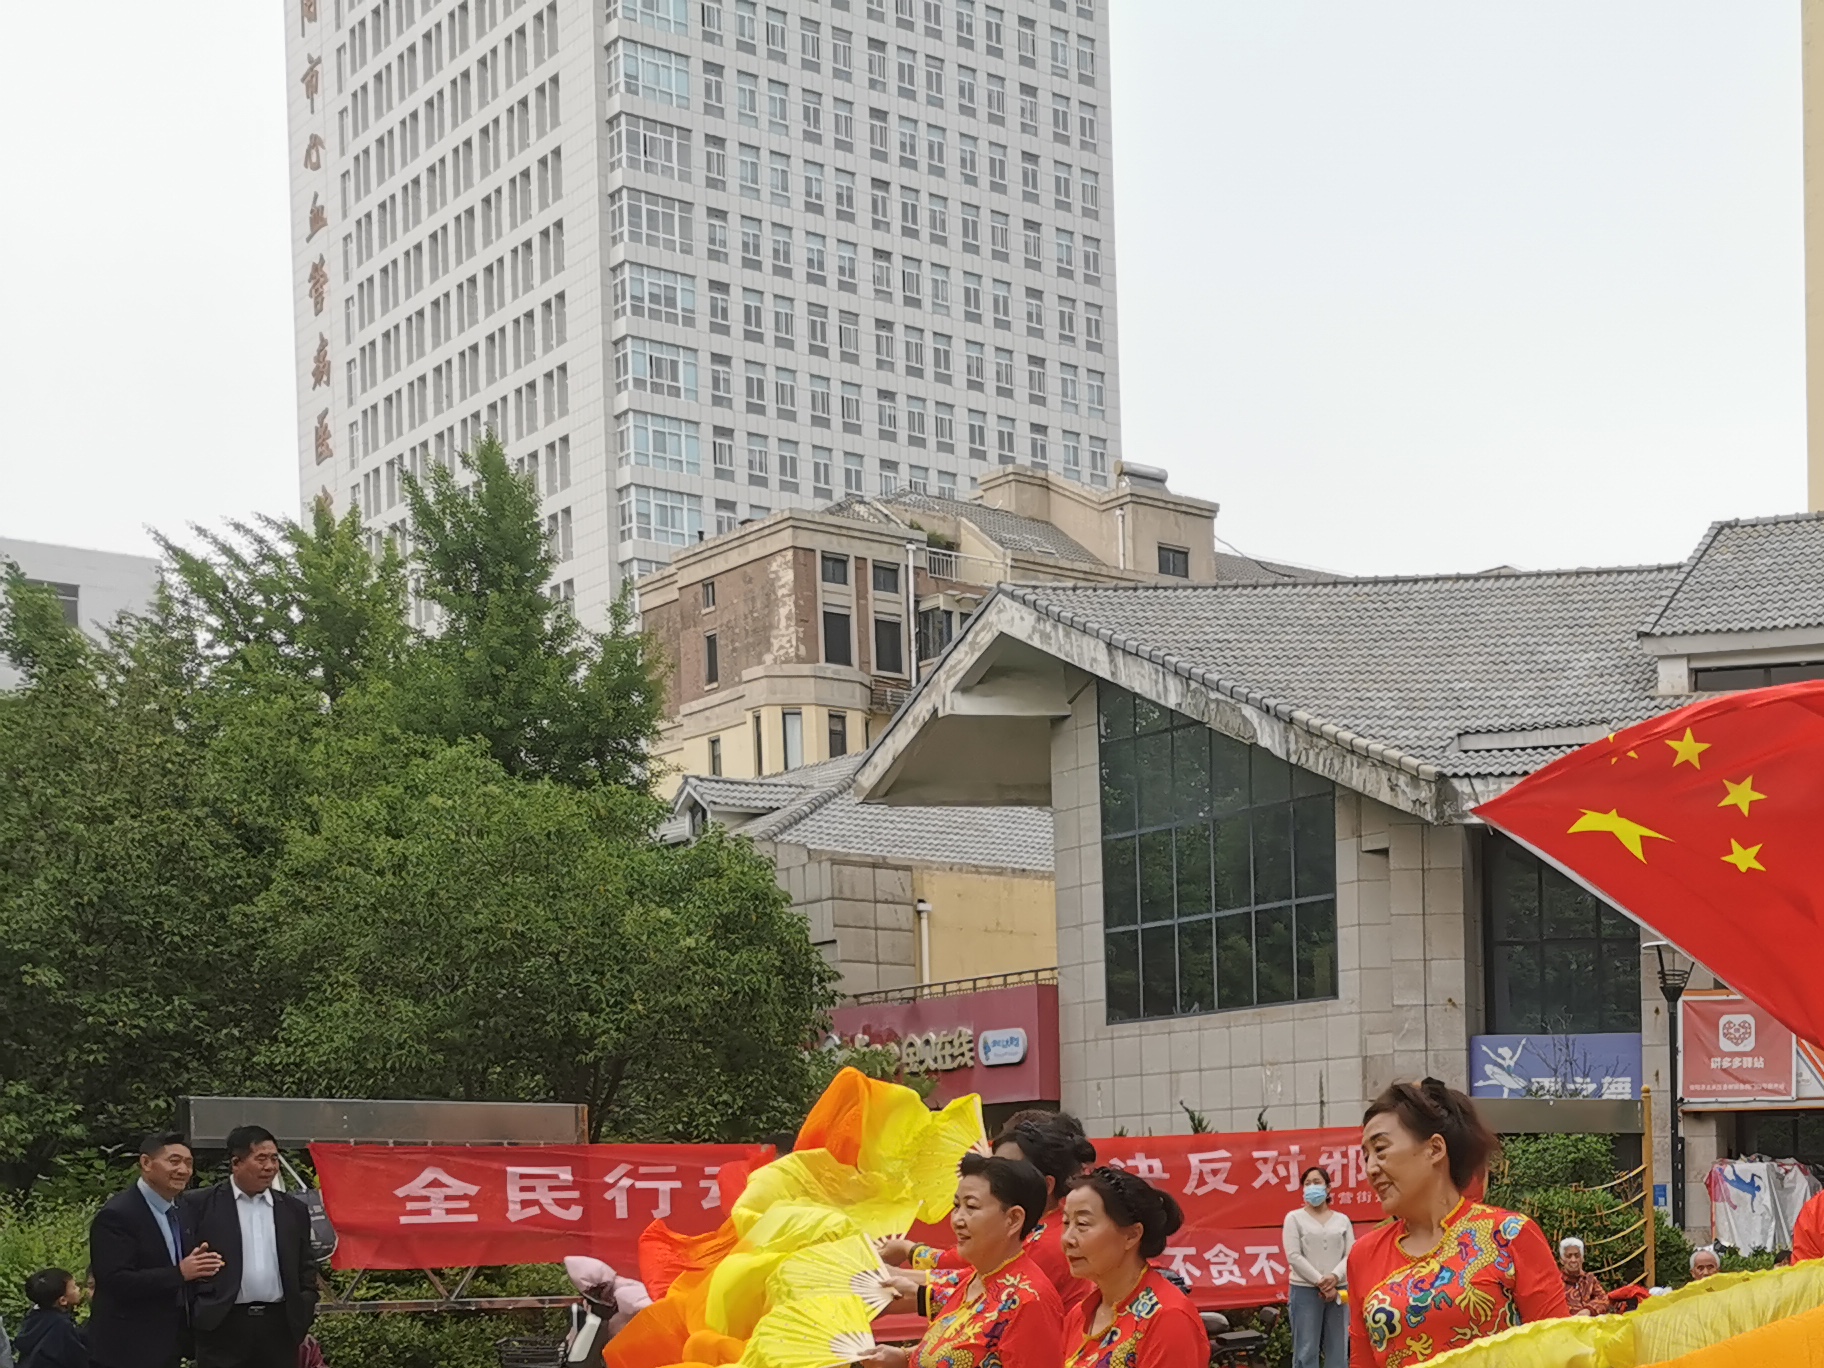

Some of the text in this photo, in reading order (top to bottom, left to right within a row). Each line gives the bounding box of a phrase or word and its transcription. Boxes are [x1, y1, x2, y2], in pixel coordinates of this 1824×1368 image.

[300, 0, 334, 525] 市心血管病医
